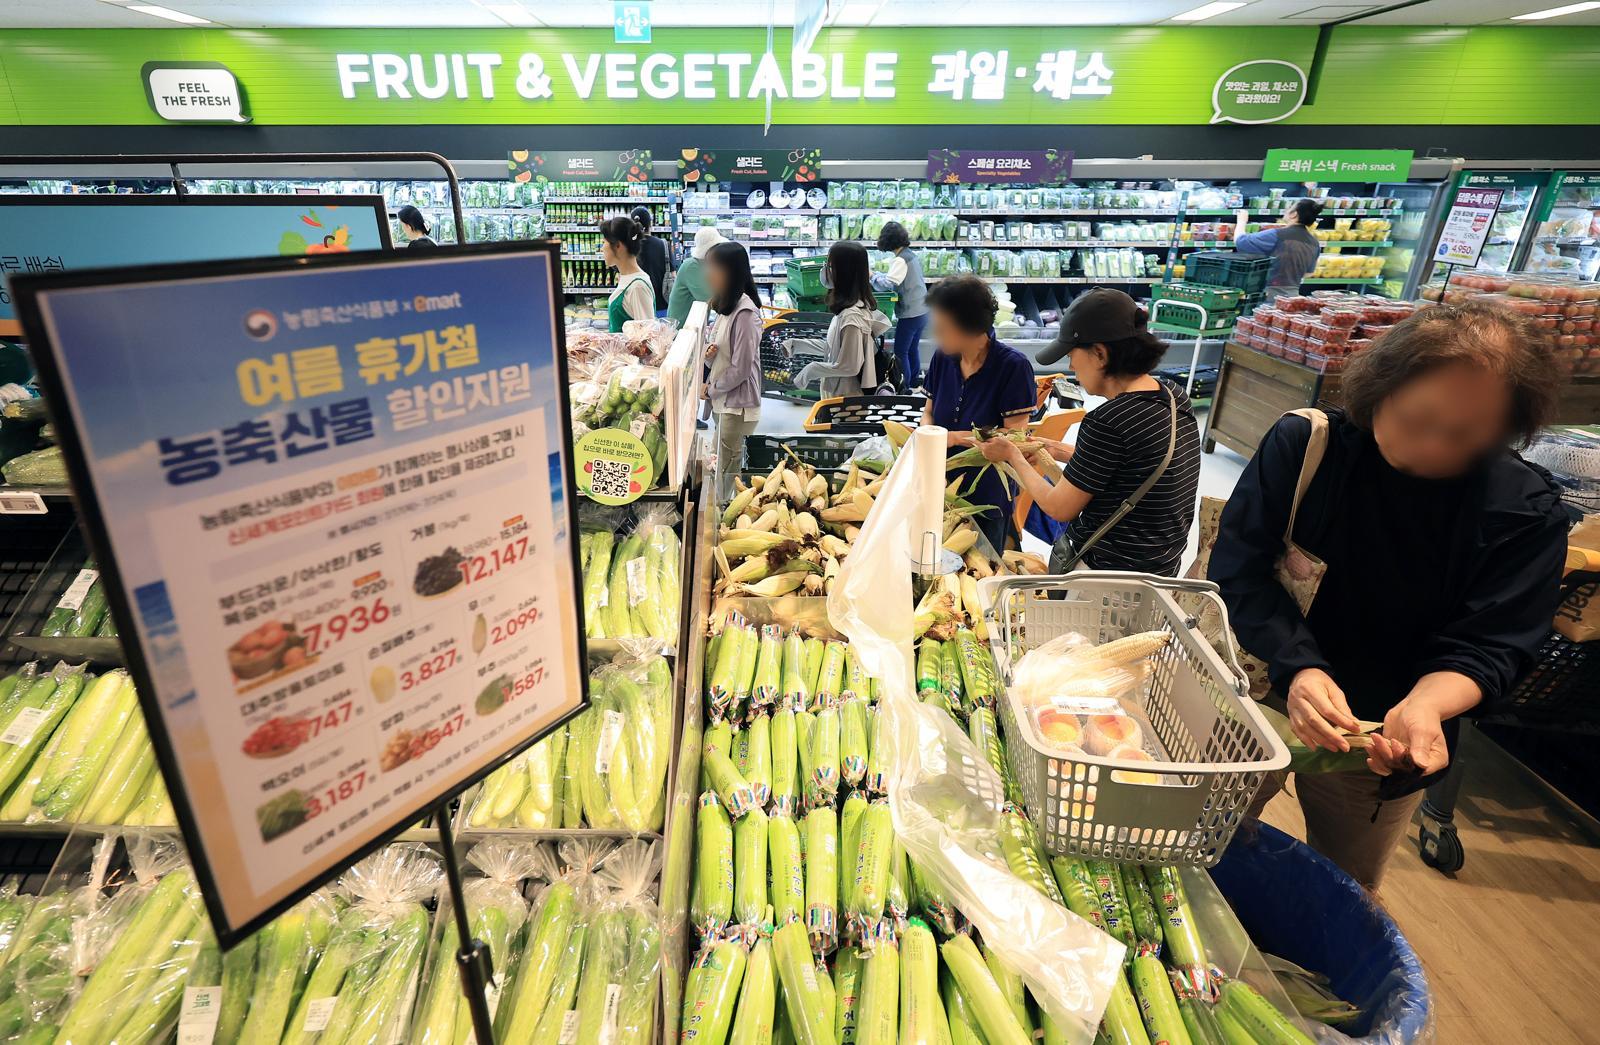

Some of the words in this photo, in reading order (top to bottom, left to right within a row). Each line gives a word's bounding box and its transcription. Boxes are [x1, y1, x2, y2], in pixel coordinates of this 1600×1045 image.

[178, 83, 210, 93] FEEL
[336, 53, 502, 99] FRUIT
[515, 52, 553, 99] &
[561, 52, 898, 99] VEGETABLE
[1225, 82, 1250, 91] 맛있는
[1272, 82, 1298, 91] 채소만
[162, 96, 187, 106] THE
[190, 96, 231, 106] FRESH
[968, 158, 995, 169] 스페셜
[996, 158, 1031, 169] 요리채소
[1278, 159, 1312, 172] 프레쉬
[1314, 159, 1339, 172] 스낵
[1341, 162, 1367, 171] Fresh
[1369, 162, 1396, 171] snack
[283, 301, 398, 331] 농림축산식품부
[414, 291, 462, 313] emart
[236, 345, 344, 406] 여름
[355, 324, 480, 385] 휴가철
[157, 397, 376, 487] 농축산물
[386, 363, 532, 432] 할인지원
[613, 440, 620, 448] 이
[583, 444, 602, 454] 집으로
[602, 448, 615, 456] 바로
[459, 536, 529, 585] 12,147
[302, 597, 390, 653] 7,936
[490, 607, 538, 645] 2,099
[400, 648, 457, 692] 3,827
[303, 769, 366, 821] 3,187
